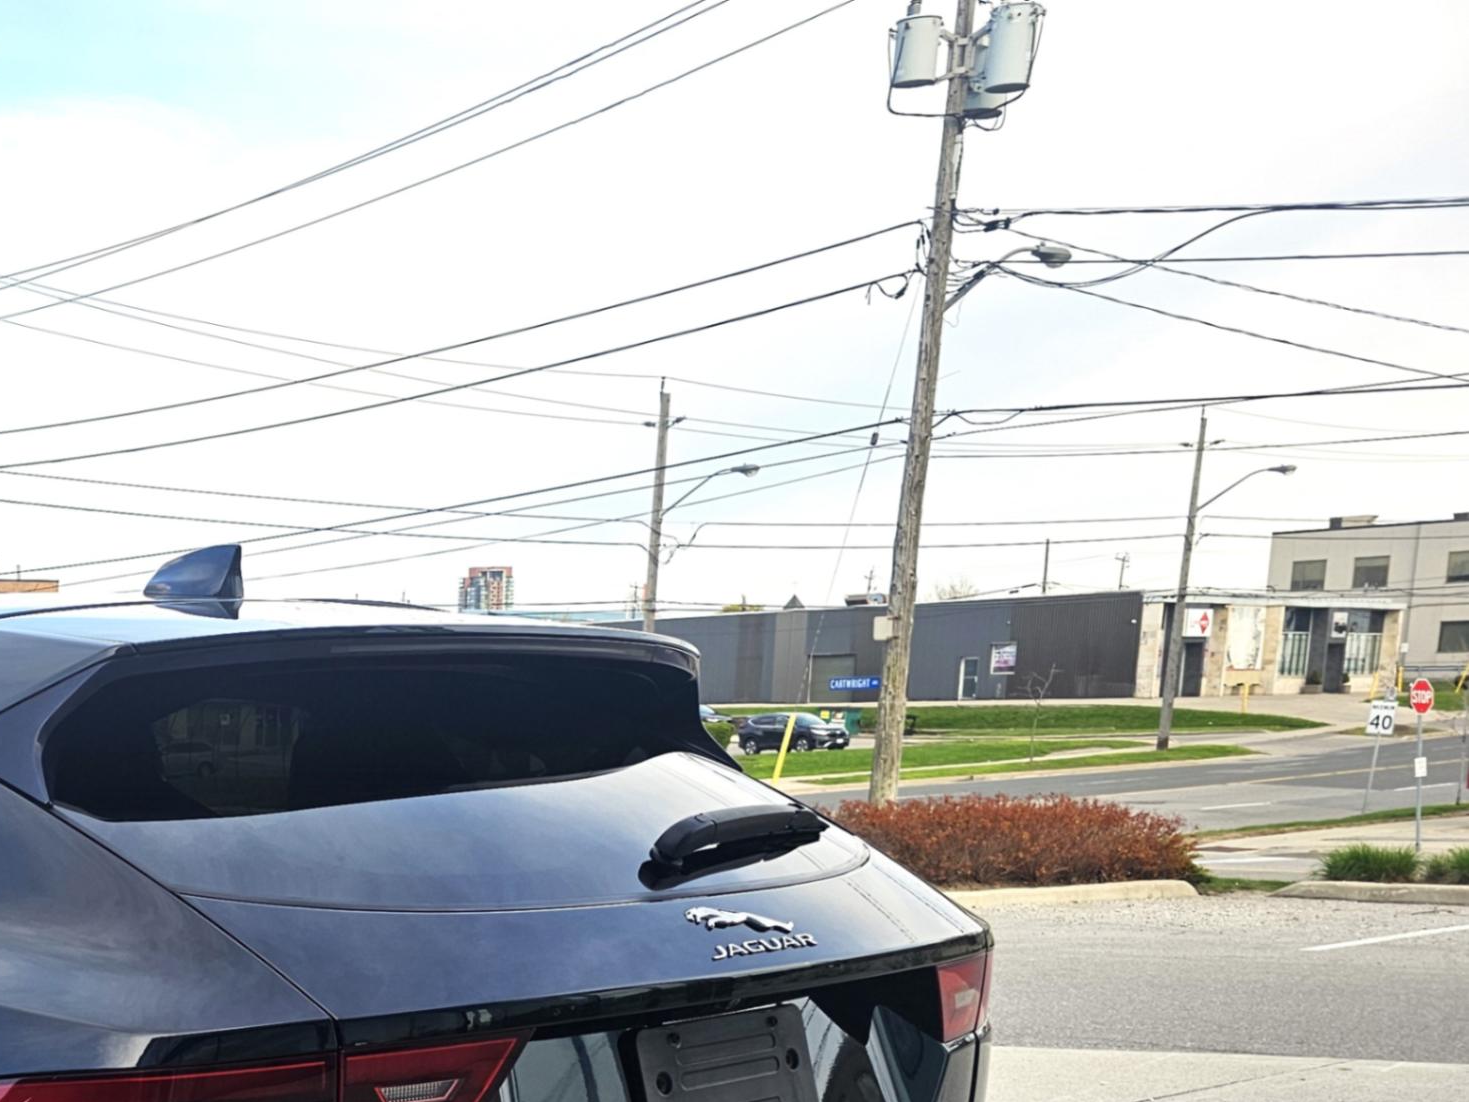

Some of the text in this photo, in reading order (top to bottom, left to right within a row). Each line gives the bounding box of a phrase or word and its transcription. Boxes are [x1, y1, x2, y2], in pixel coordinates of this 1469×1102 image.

[1411, 690, 1432, 703] STOP
[1370, 714, 1393, 730] 40
[712, 933, 818, 961] JAGUAR
